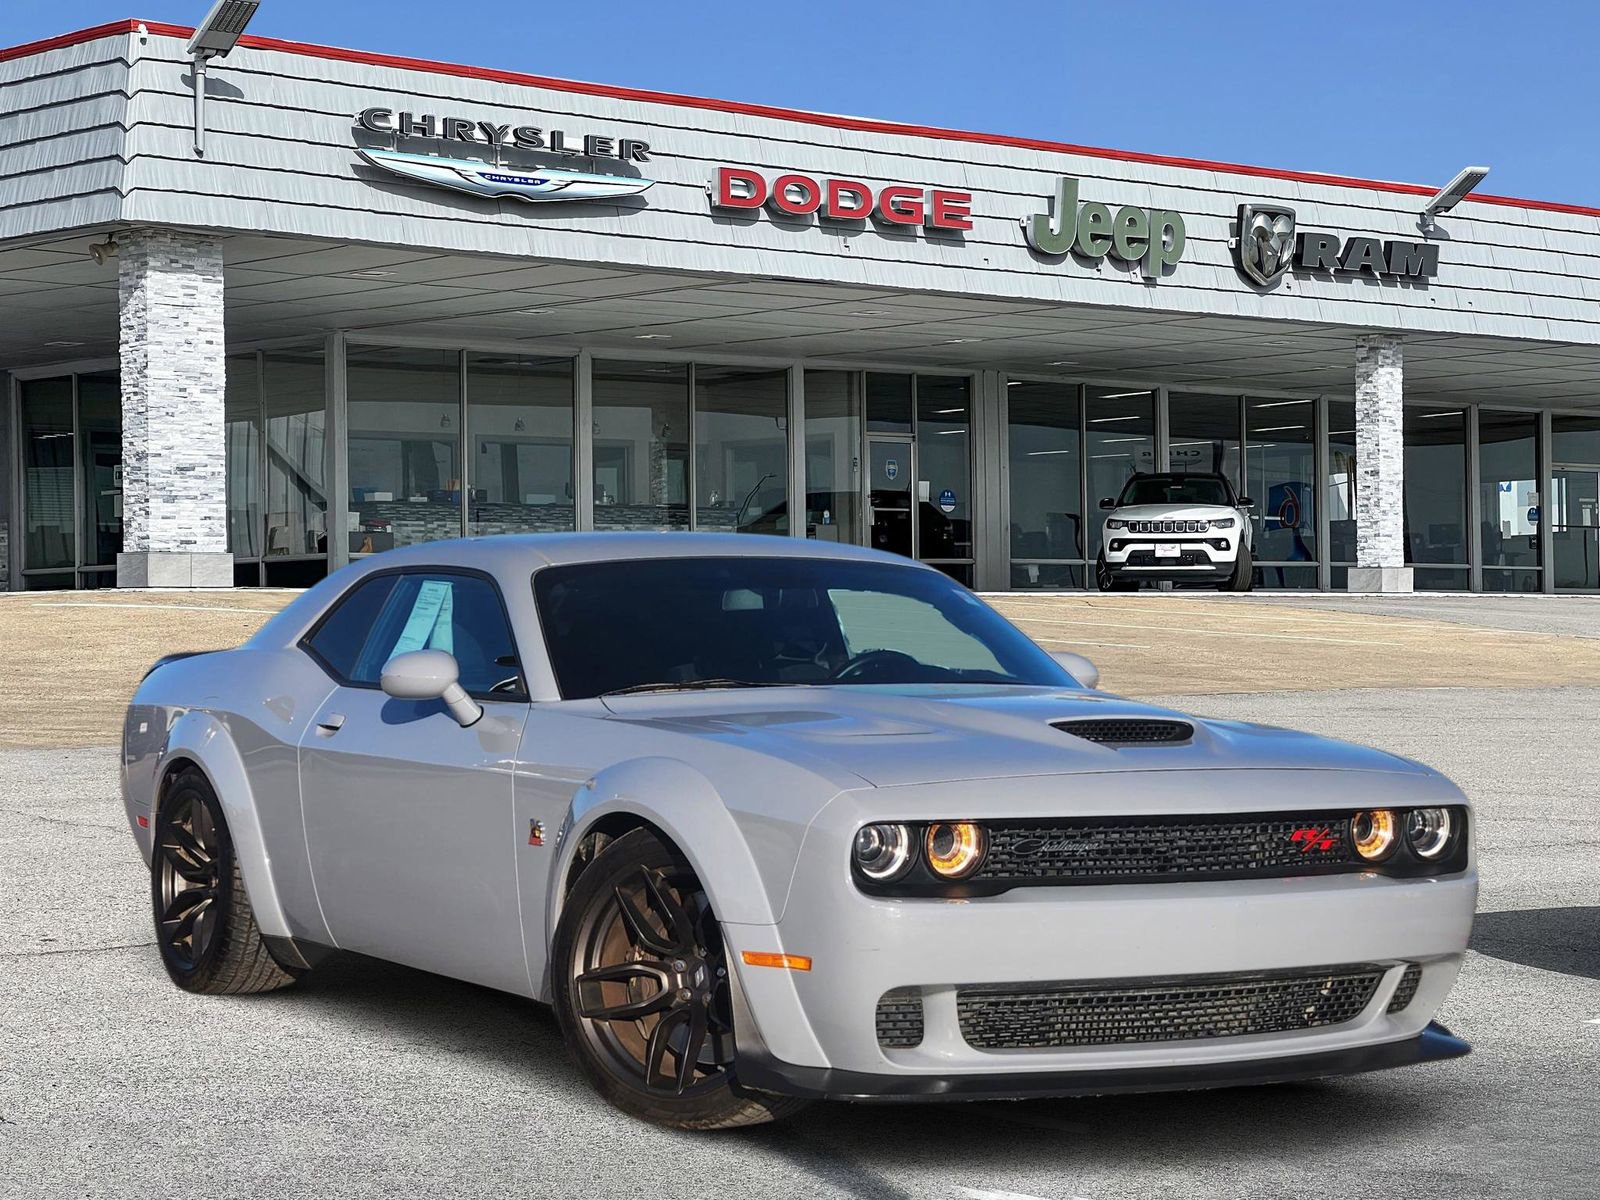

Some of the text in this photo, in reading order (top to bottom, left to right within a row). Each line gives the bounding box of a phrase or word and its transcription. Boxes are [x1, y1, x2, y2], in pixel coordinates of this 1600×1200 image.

[357, 106, 651, 162] CHRYSLER
[484, 174, 541, 185] CHRYSLER
[714, 166, 974, 230] DODGE
[1028, 176, 1187, 279] Jeep
[1297, 232, 1440, 277] RAM
[1012, 838, 1100, 855] Challenger
[1290, 827, 1337, 853] R/T
